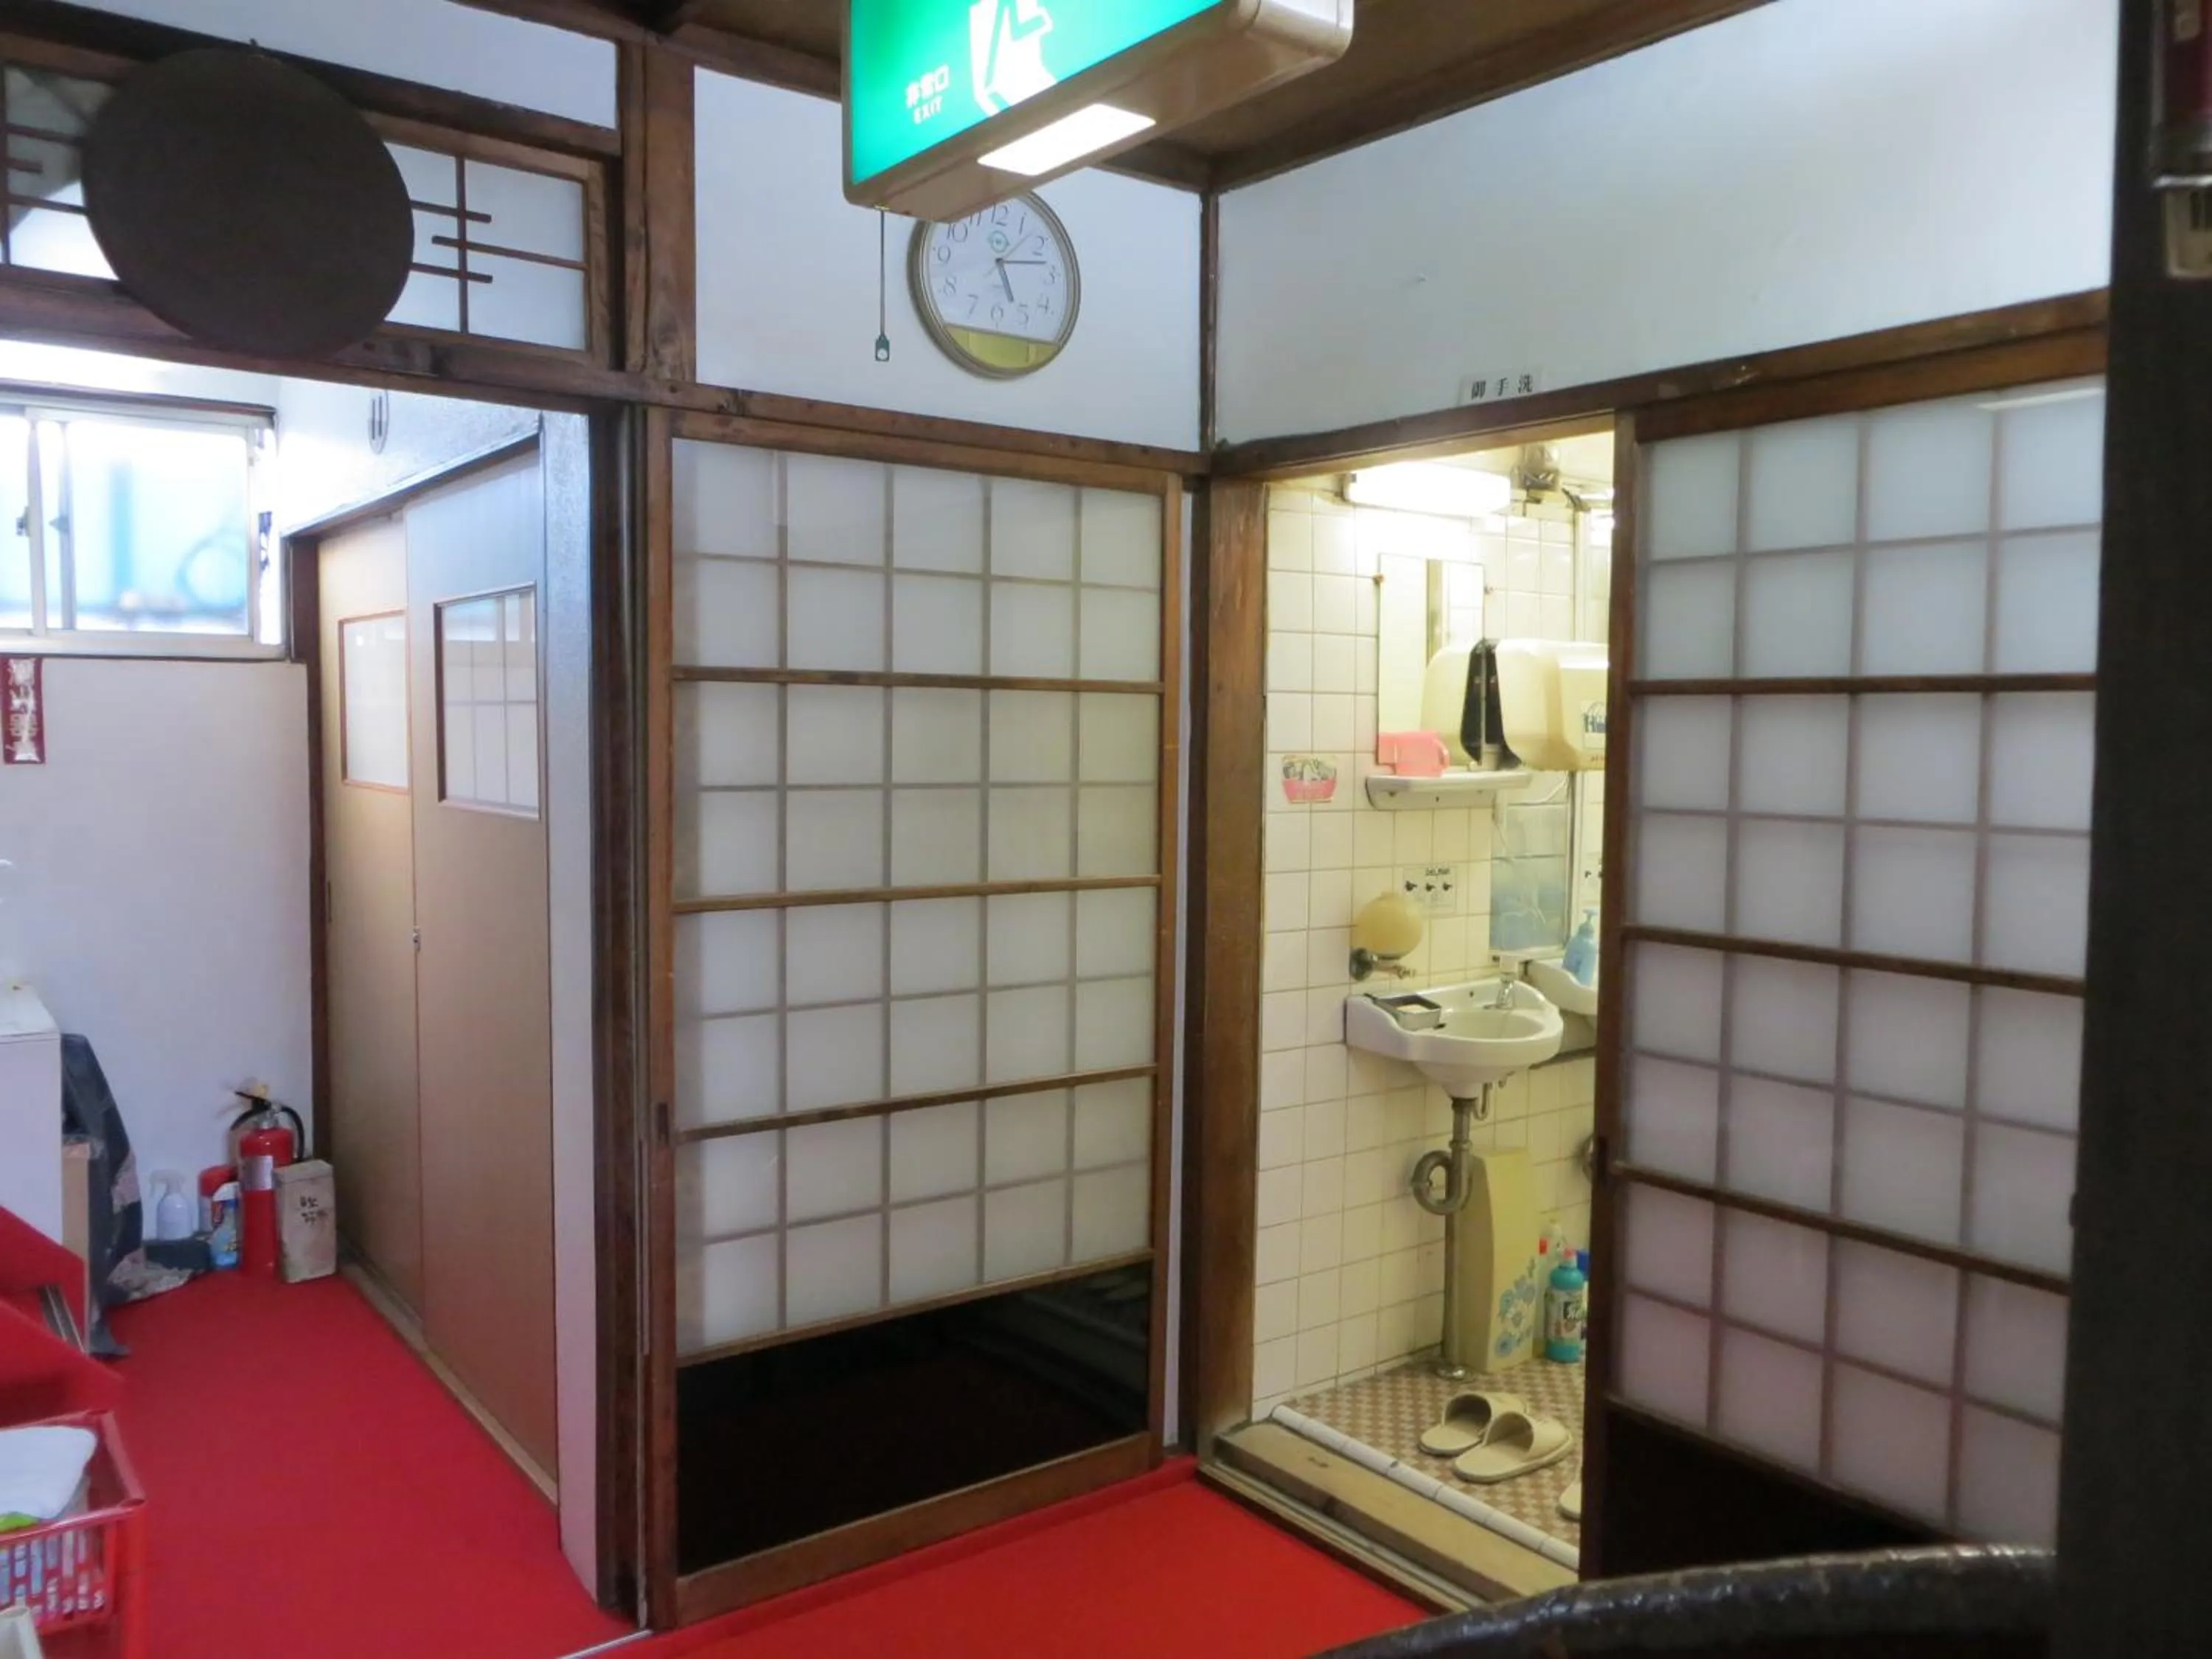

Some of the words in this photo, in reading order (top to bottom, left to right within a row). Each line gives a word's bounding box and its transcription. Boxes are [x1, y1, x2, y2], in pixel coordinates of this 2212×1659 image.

[914, 96, 943, 125] EXIT
[947, 223, 968, 243] 10
[1032, 235, 1045, 256] 2
[967, 294, 978, 316] 7
[1036, 294, 1049, 314] 4
